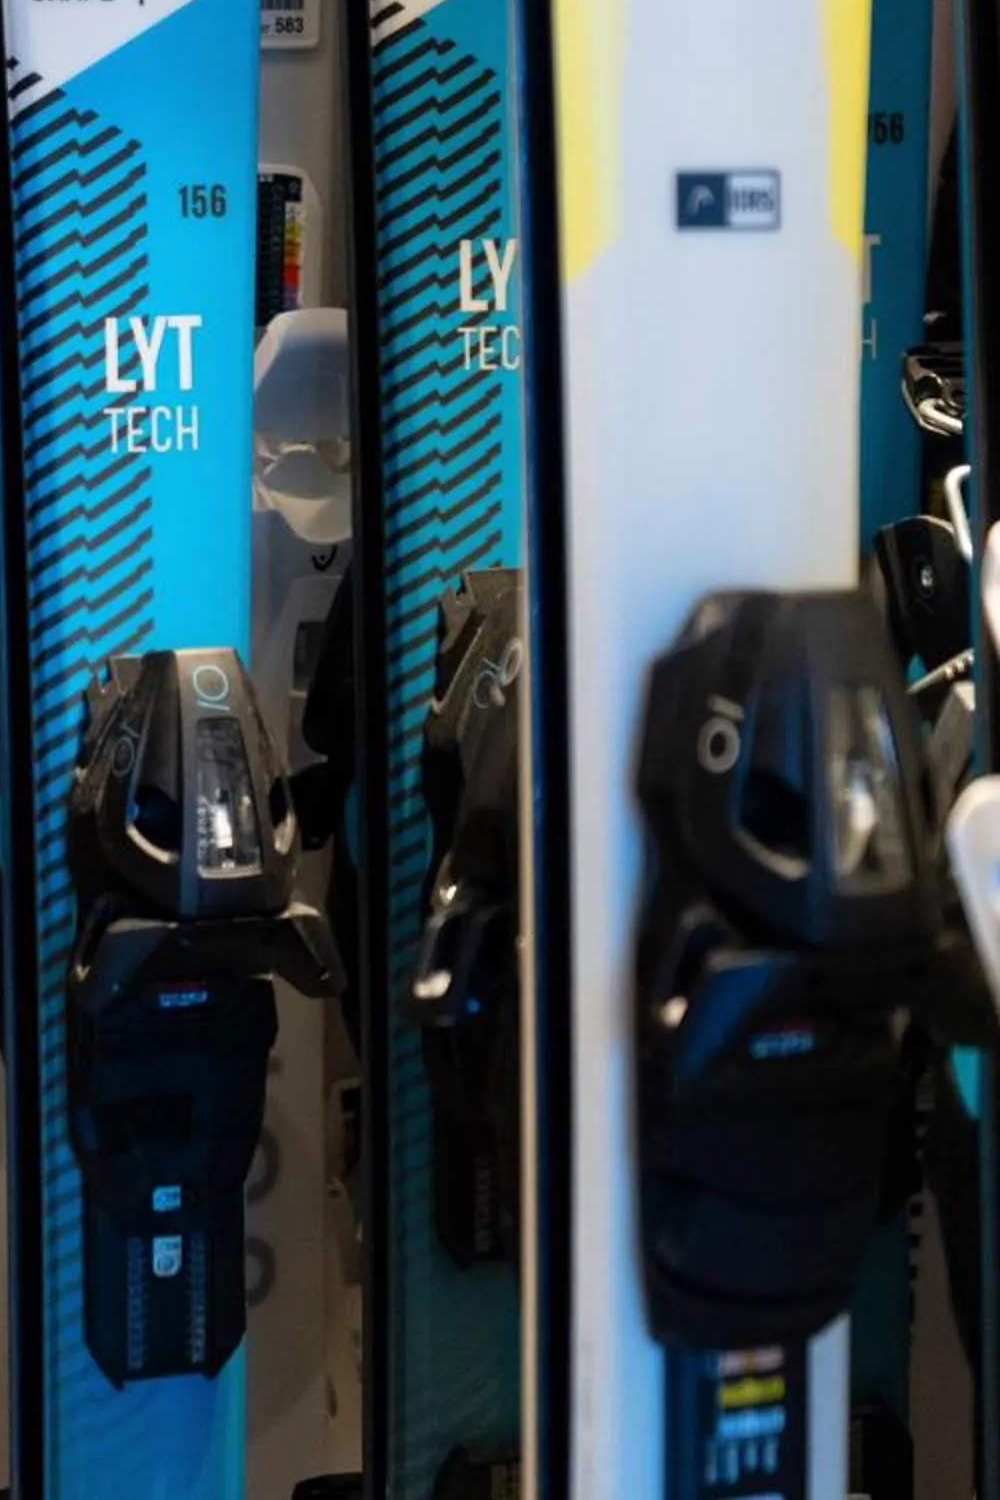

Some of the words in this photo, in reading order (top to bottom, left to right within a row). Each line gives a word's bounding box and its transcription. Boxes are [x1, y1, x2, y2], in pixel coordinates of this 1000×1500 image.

[868, 112, 905, 146] 56
[177, 183, 228, 219] 156
[458, 238, 517, 312] LY
[104, 314, 202, 393] LYT
[458, 325, 521, 371] TEC
[102, 405, 200, 454] TECH
